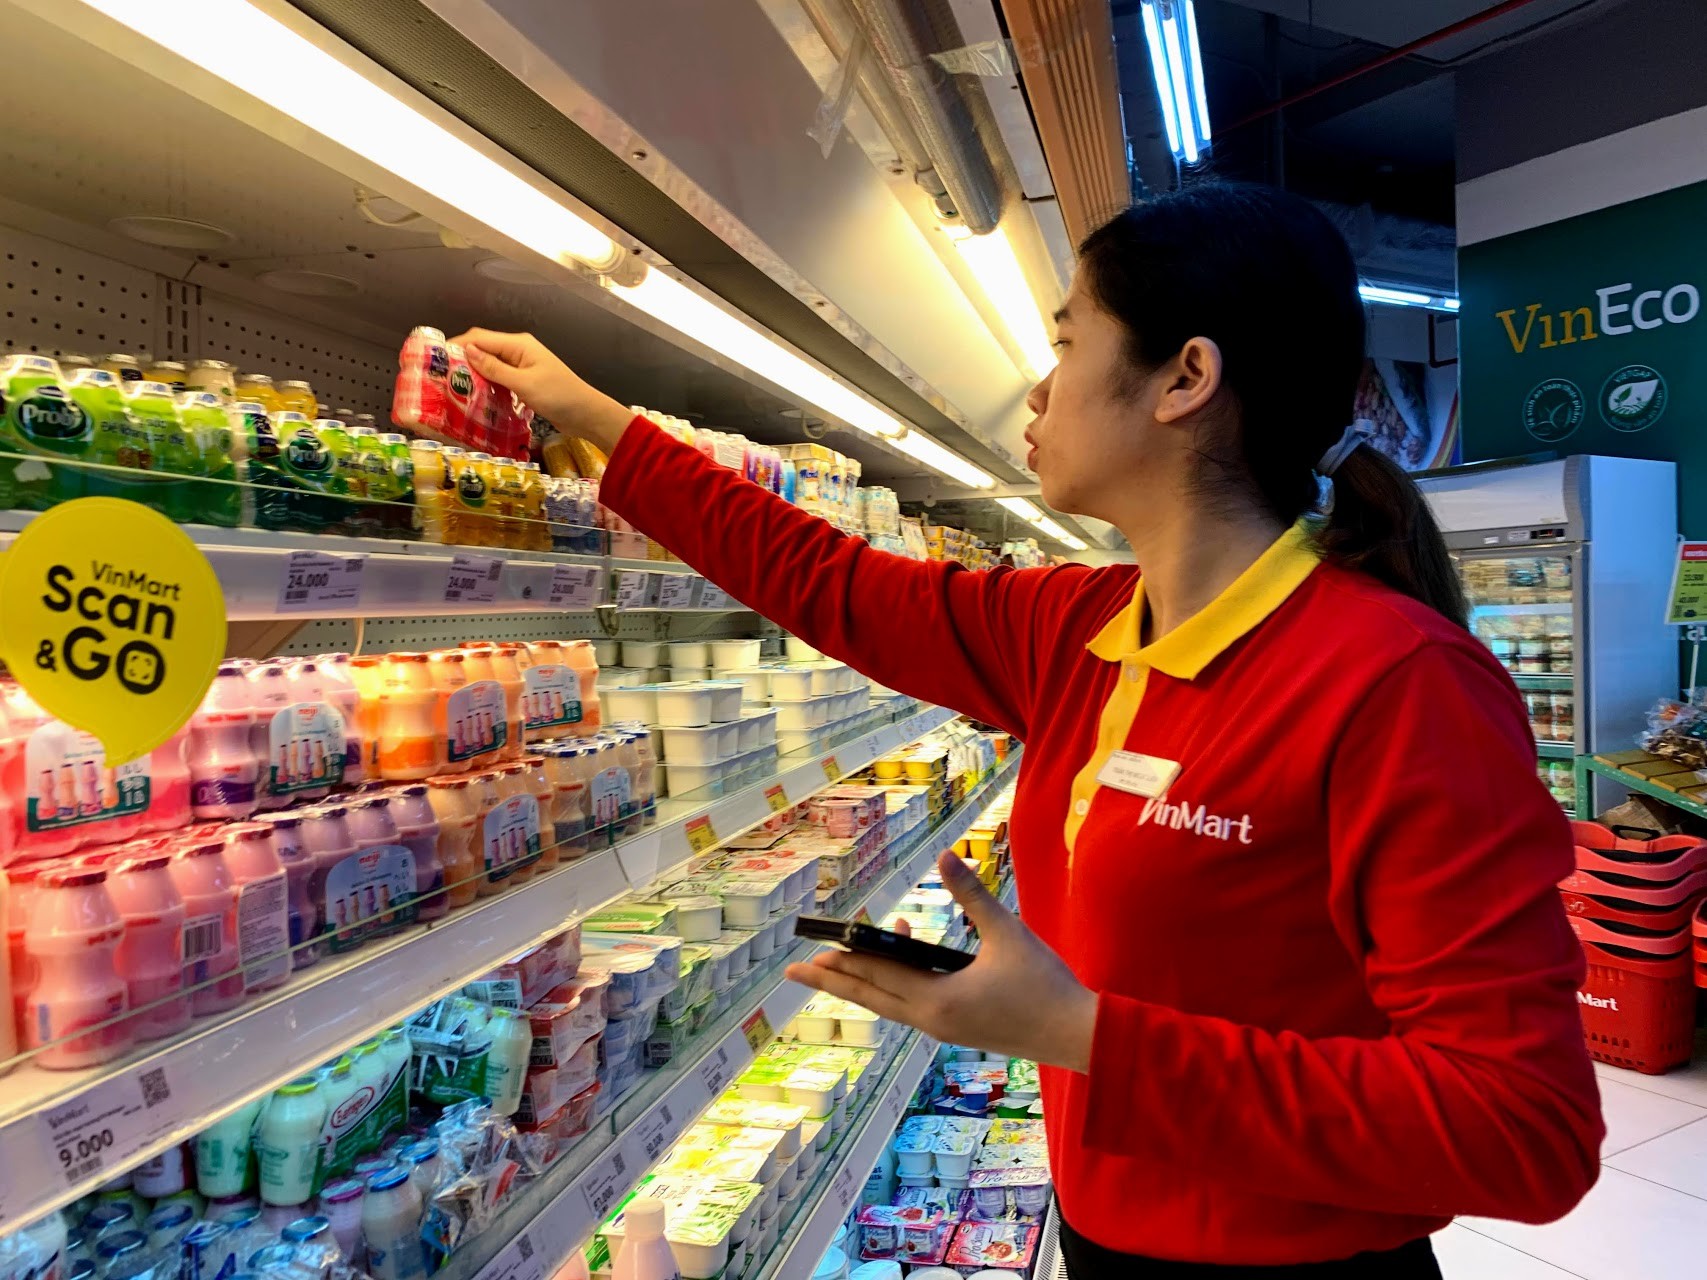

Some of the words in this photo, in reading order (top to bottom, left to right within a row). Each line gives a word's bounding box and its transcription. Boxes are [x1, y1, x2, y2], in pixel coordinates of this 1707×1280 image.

[1496, 283, 1700, 353] VinEco
[42, 565, 176, 640] Scan
[92, 560, 181, 601] VinMart
[287, 573, 329, 589] 24.000
[1137, 792, 1253, 844] VinMart
[59, 1128, 114, 1168] 9.000
